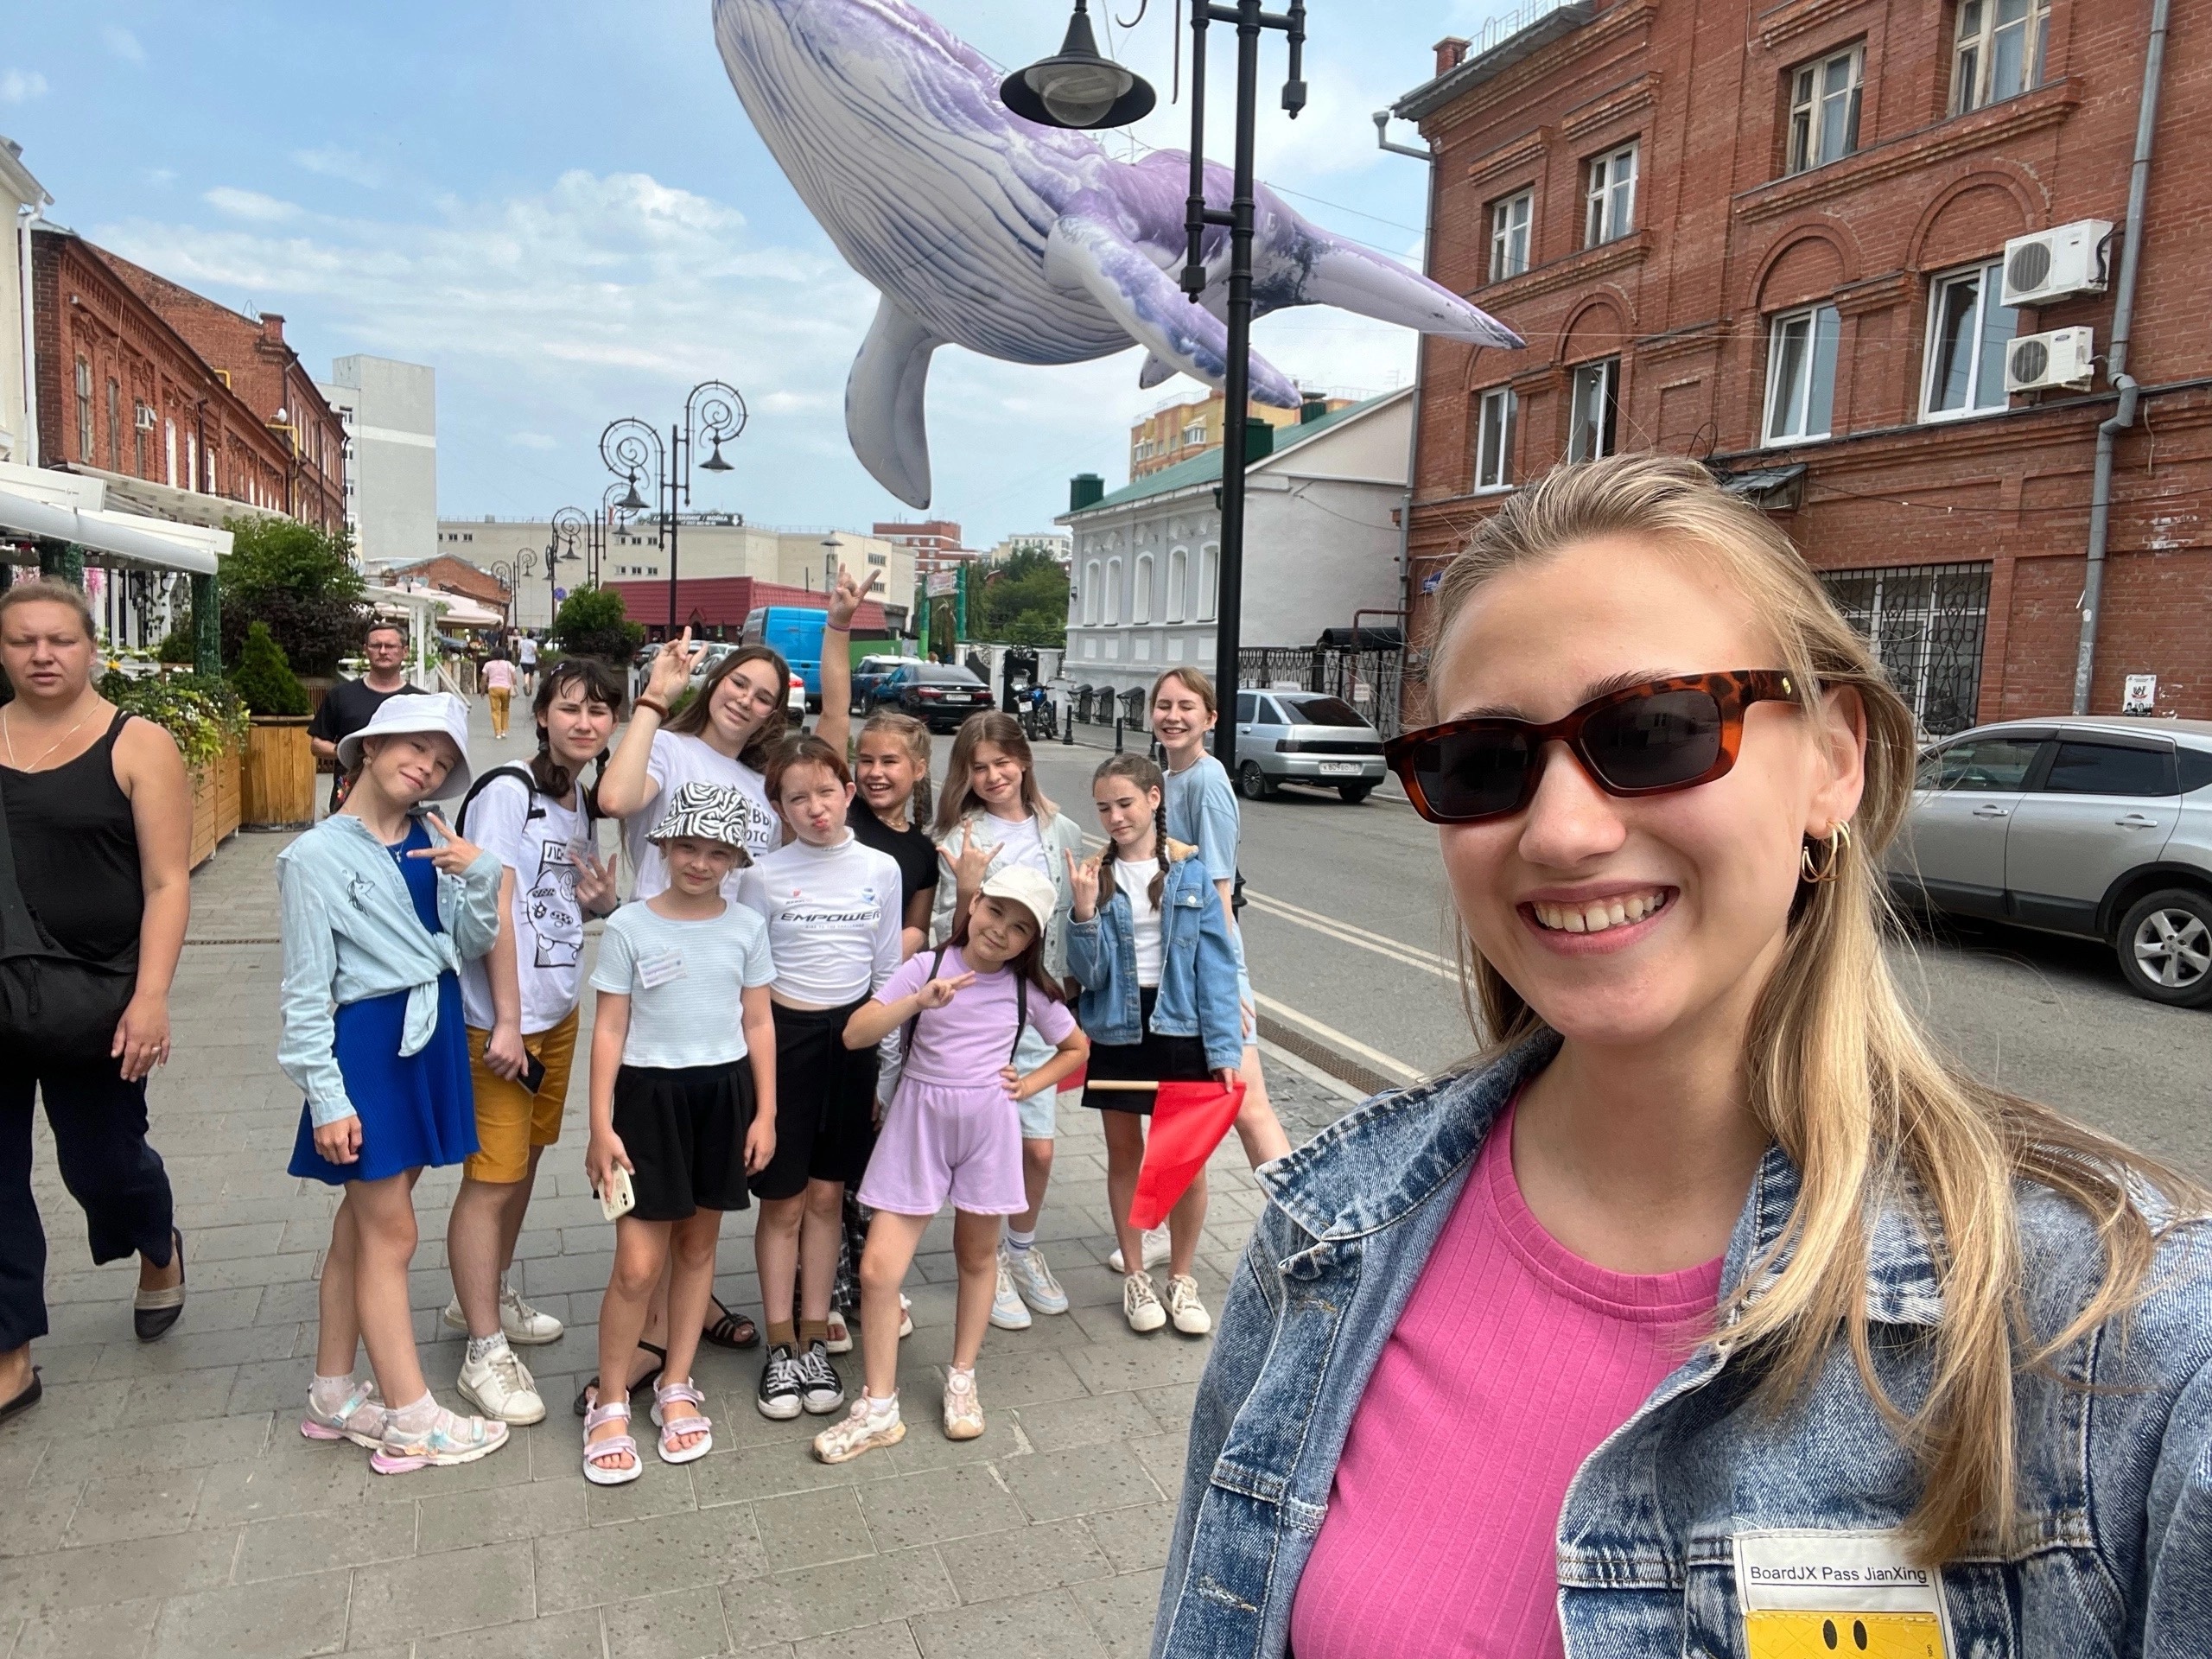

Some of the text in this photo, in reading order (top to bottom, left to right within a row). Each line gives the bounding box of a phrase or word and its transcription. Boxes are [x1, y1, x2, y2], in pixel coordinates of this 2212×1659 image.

[780, 911, 880, 922] EMPOWER
[1751, 1567, 1927, 1583] BoardJX Pass JianXing
